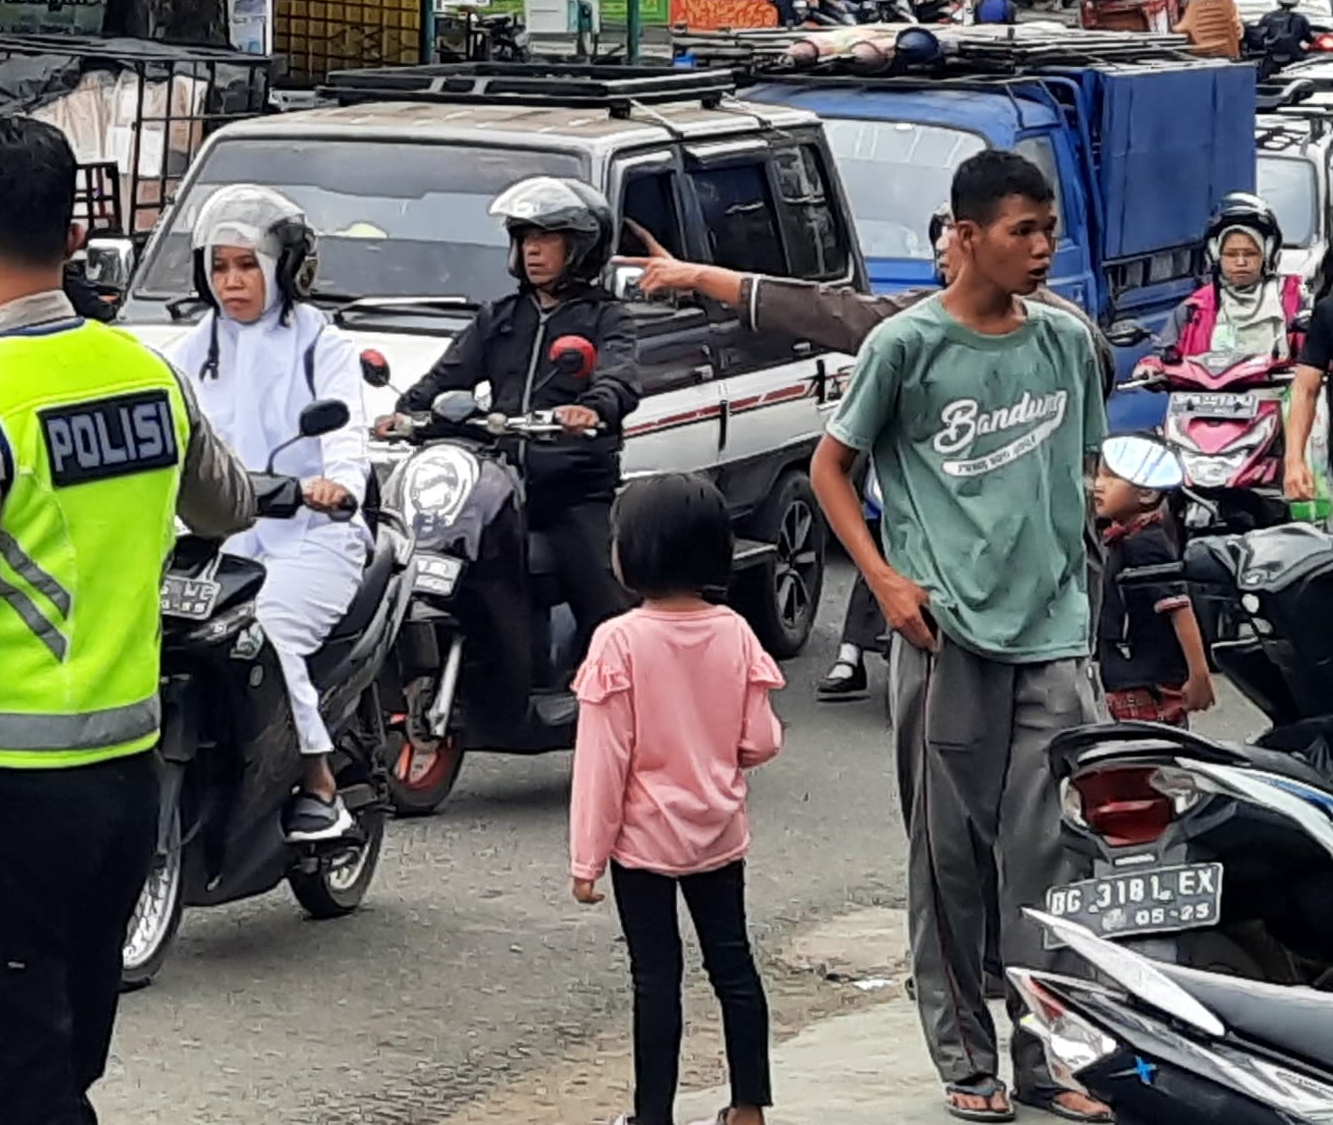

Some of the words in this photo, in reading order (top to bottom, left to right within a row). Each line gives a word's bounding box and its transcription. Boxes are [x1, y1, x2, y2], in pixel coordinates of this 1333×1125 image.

[45, 401, 176, 473] POLISI
[933, 389, 1067, 454] Bandung
[1050, 889, 1082, 916] BG
[1179, 868, 1215, 896] EX
